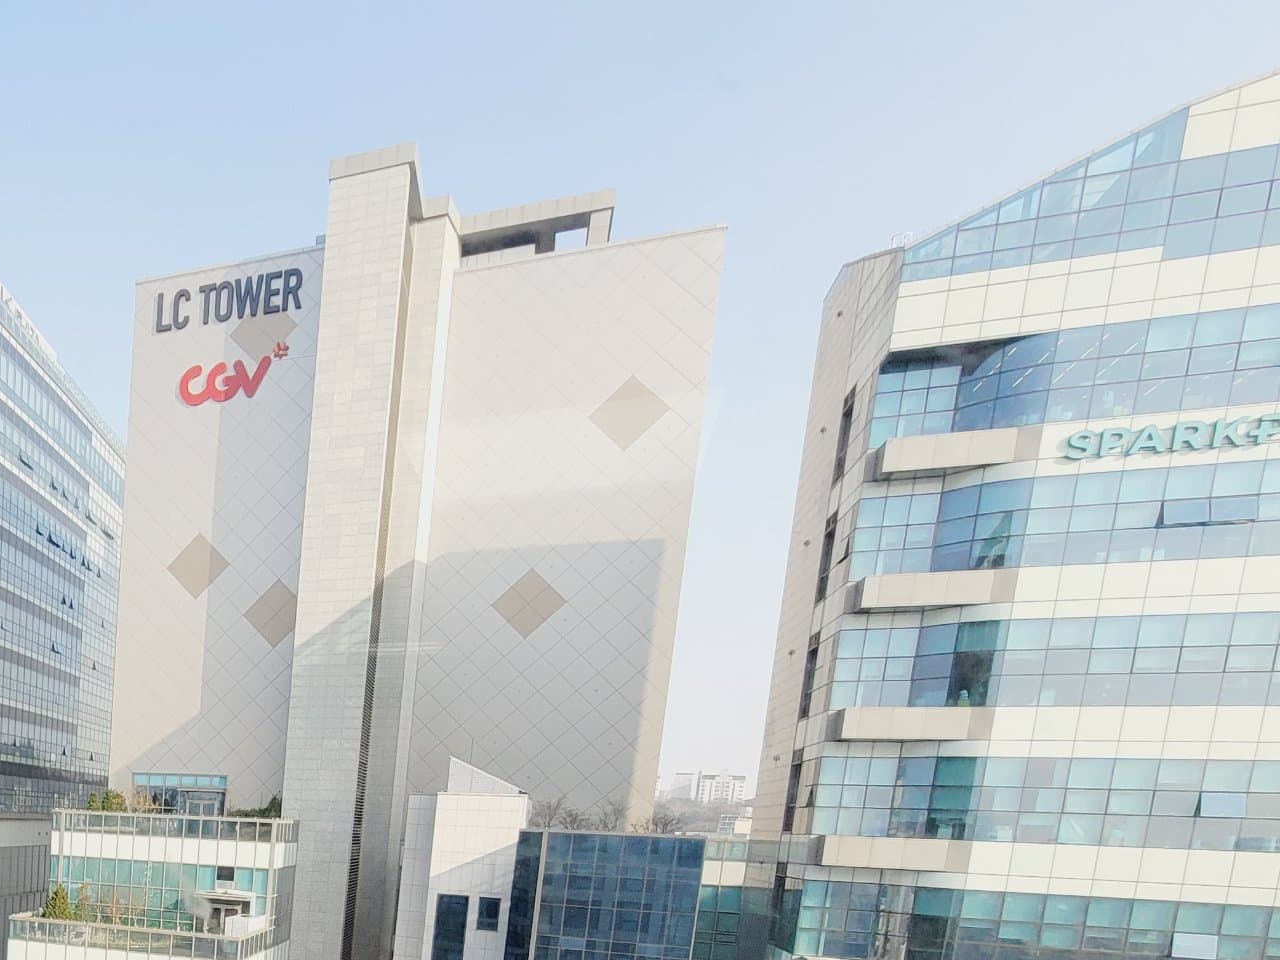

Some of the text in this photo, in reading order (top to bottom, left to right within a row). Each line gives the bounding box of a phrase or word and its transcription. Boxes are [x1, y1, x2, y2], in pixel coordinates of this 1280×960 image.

[155, 268, 303, 333] LC TOWER
[179, 356, 272, 406] CGV
